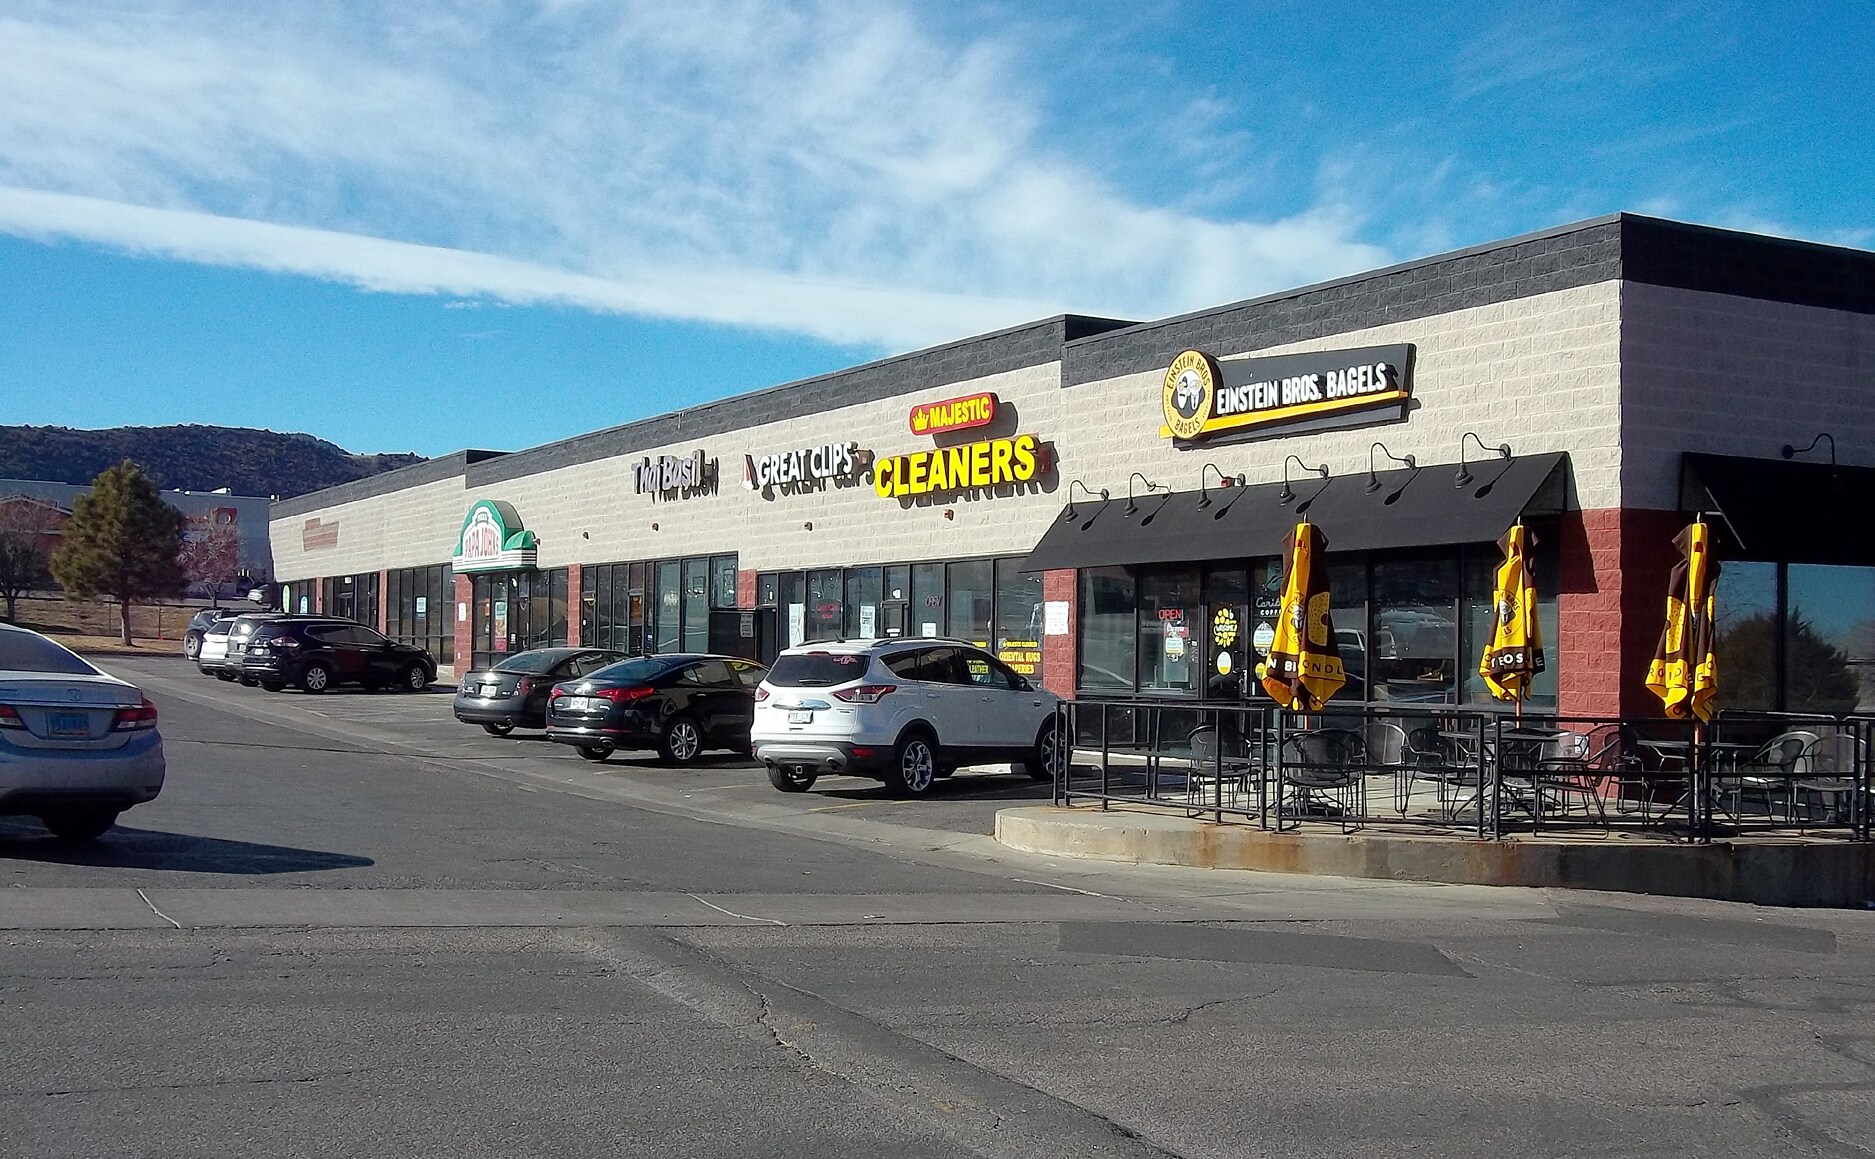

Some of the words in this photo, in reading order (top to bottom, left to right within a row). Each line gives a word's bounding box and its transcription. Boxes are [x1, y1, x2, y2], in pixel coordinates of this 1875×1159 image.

[1167, 354, 1195, 389] EINSTEIN
[1195, 358, 1211, 386] BROS
[1216, 379, 1279, 415] EINSTEIN
[1282, 373, 1322, 405] BROS.
[1326, 362, 1386, 399] BAGELS
[929, 396, 990, 429] MAJESTIC
[1174, 417, 1201, 435] BAGELS
[631, 456, 660, 494] Thai
[662, 449, 704, 491] Basil
[757, 449, 806, 486] GREAT
[810, 441, 853, 478] CLIPS
[874, 435, 1035, 498] CLEANERS
[465, 529, 480, 558] PAPA
[924, 595, 943, 608] OPEN
[1256, 597, 1281, 608] Carib
[1158, 609, 1182, 620] OPEN
[999, 651, 1025, 662] ORIENTAL
[1025, 651, 1041, 663] RUGS
[1007, 663, 1035, 674] APERIES
[969, 665, 988, 674] LEATHER
